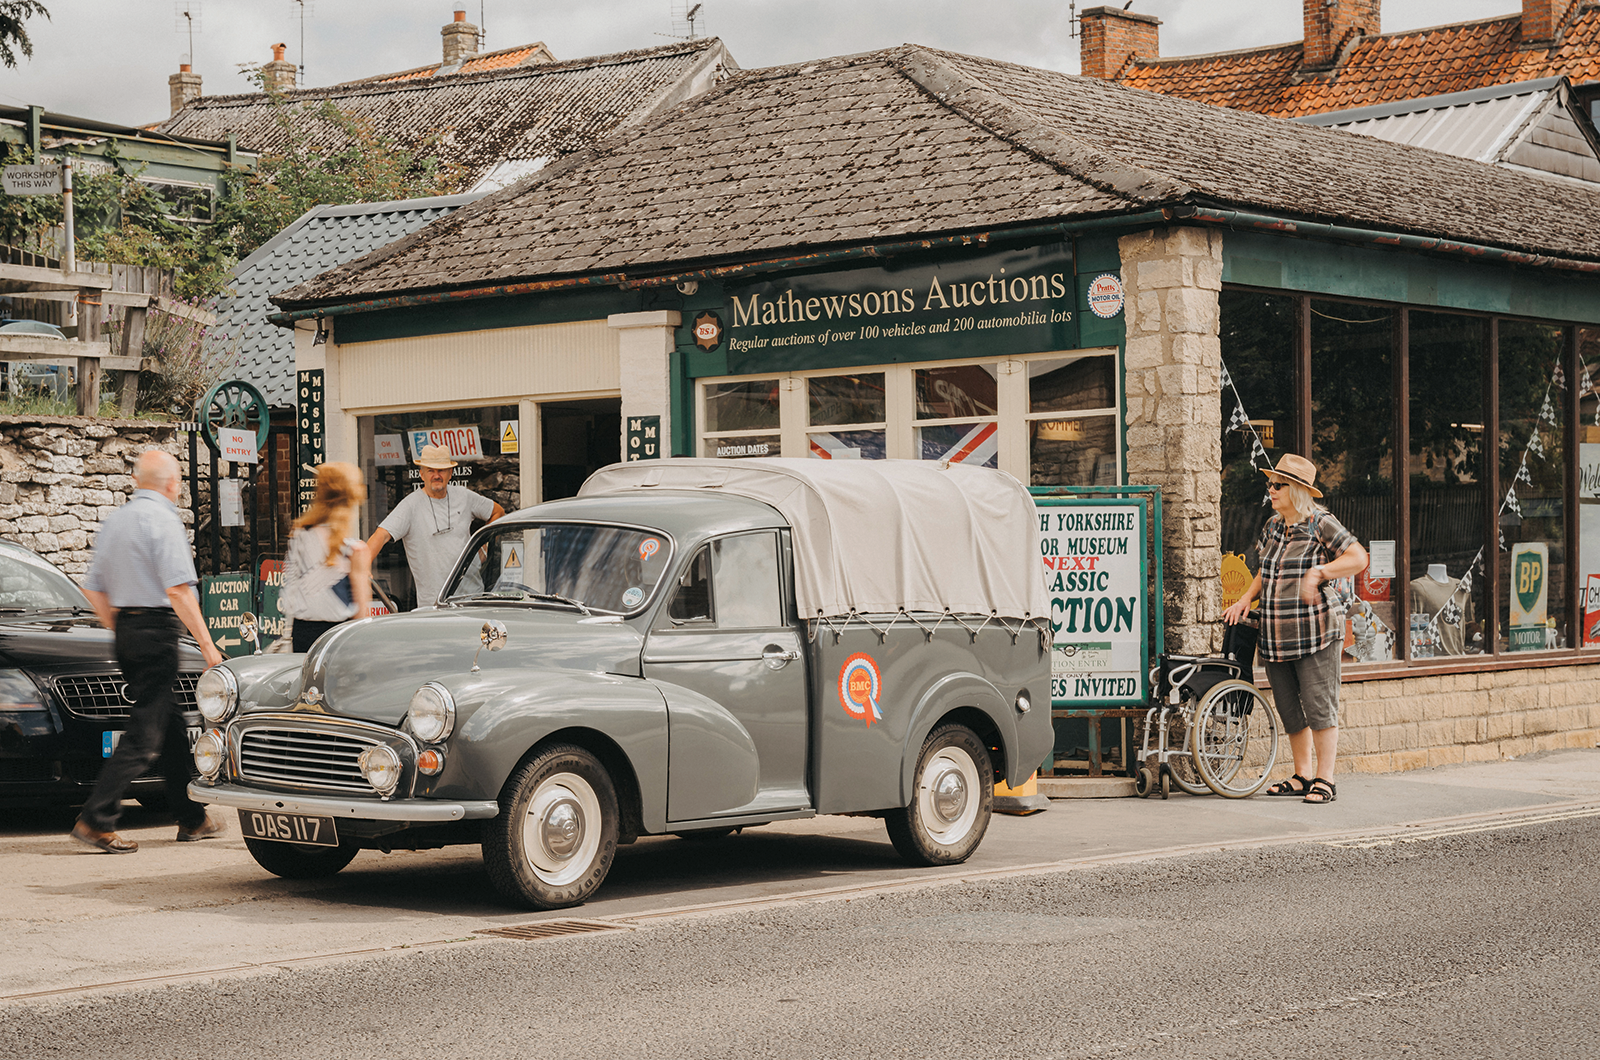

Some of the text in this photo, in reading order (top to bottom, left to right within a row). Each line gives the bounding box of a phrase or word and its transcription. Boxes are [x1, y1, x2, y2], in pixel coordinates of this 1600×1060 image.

[7, 171, 58, 180] WORKSHOP
[34, 180, 53, 188] WAY
[730, 267, 1066, 328] Mathewsons Auctions
[1092, 293, 1121, 302] MOTOR OIL
[699, 326, 715, 336] BSA
[729, 309, 1072, 353] Regular auctions of over 100 vehicles and 200 automobilia lots
[300, 371, 310, 445] MOTOR
[312, 376, 323, 465] MUSEUM
[231, 435, 244, 444] NO
[430, 428, 478, 457] SIMCA
[630, 419, 642, 462] MOT
[226, 447, 252, 456] ENTRY
[717, 443, 770, 457] AUCTION DATES
[452, 466, 473, 477] ALES
[1057, 512, 1135, 532] YORKSHIRE
[1067, 536, 1129, 556] MUSEUM
[1042, 556, 1100, 571] NEXT
[1046, 571, 1109, 592] ASSIC
[1518, 562, 1541, 594] BP
[208, 580, 250, 595] AUCTION
[219, 598, 239, 611] CAR
[365, 606, 390, 617] ARKIN
[208, 615, 241, 629] PARKI
[1514, 631, 1541, 645] MOTOR
[1078, 659, 1108, 668] ENTRY
[850, 681, 871, 691] BMC
[1074, 677, 1136, 697] INVITED
[251, 813, 321, 842] OAS 117
